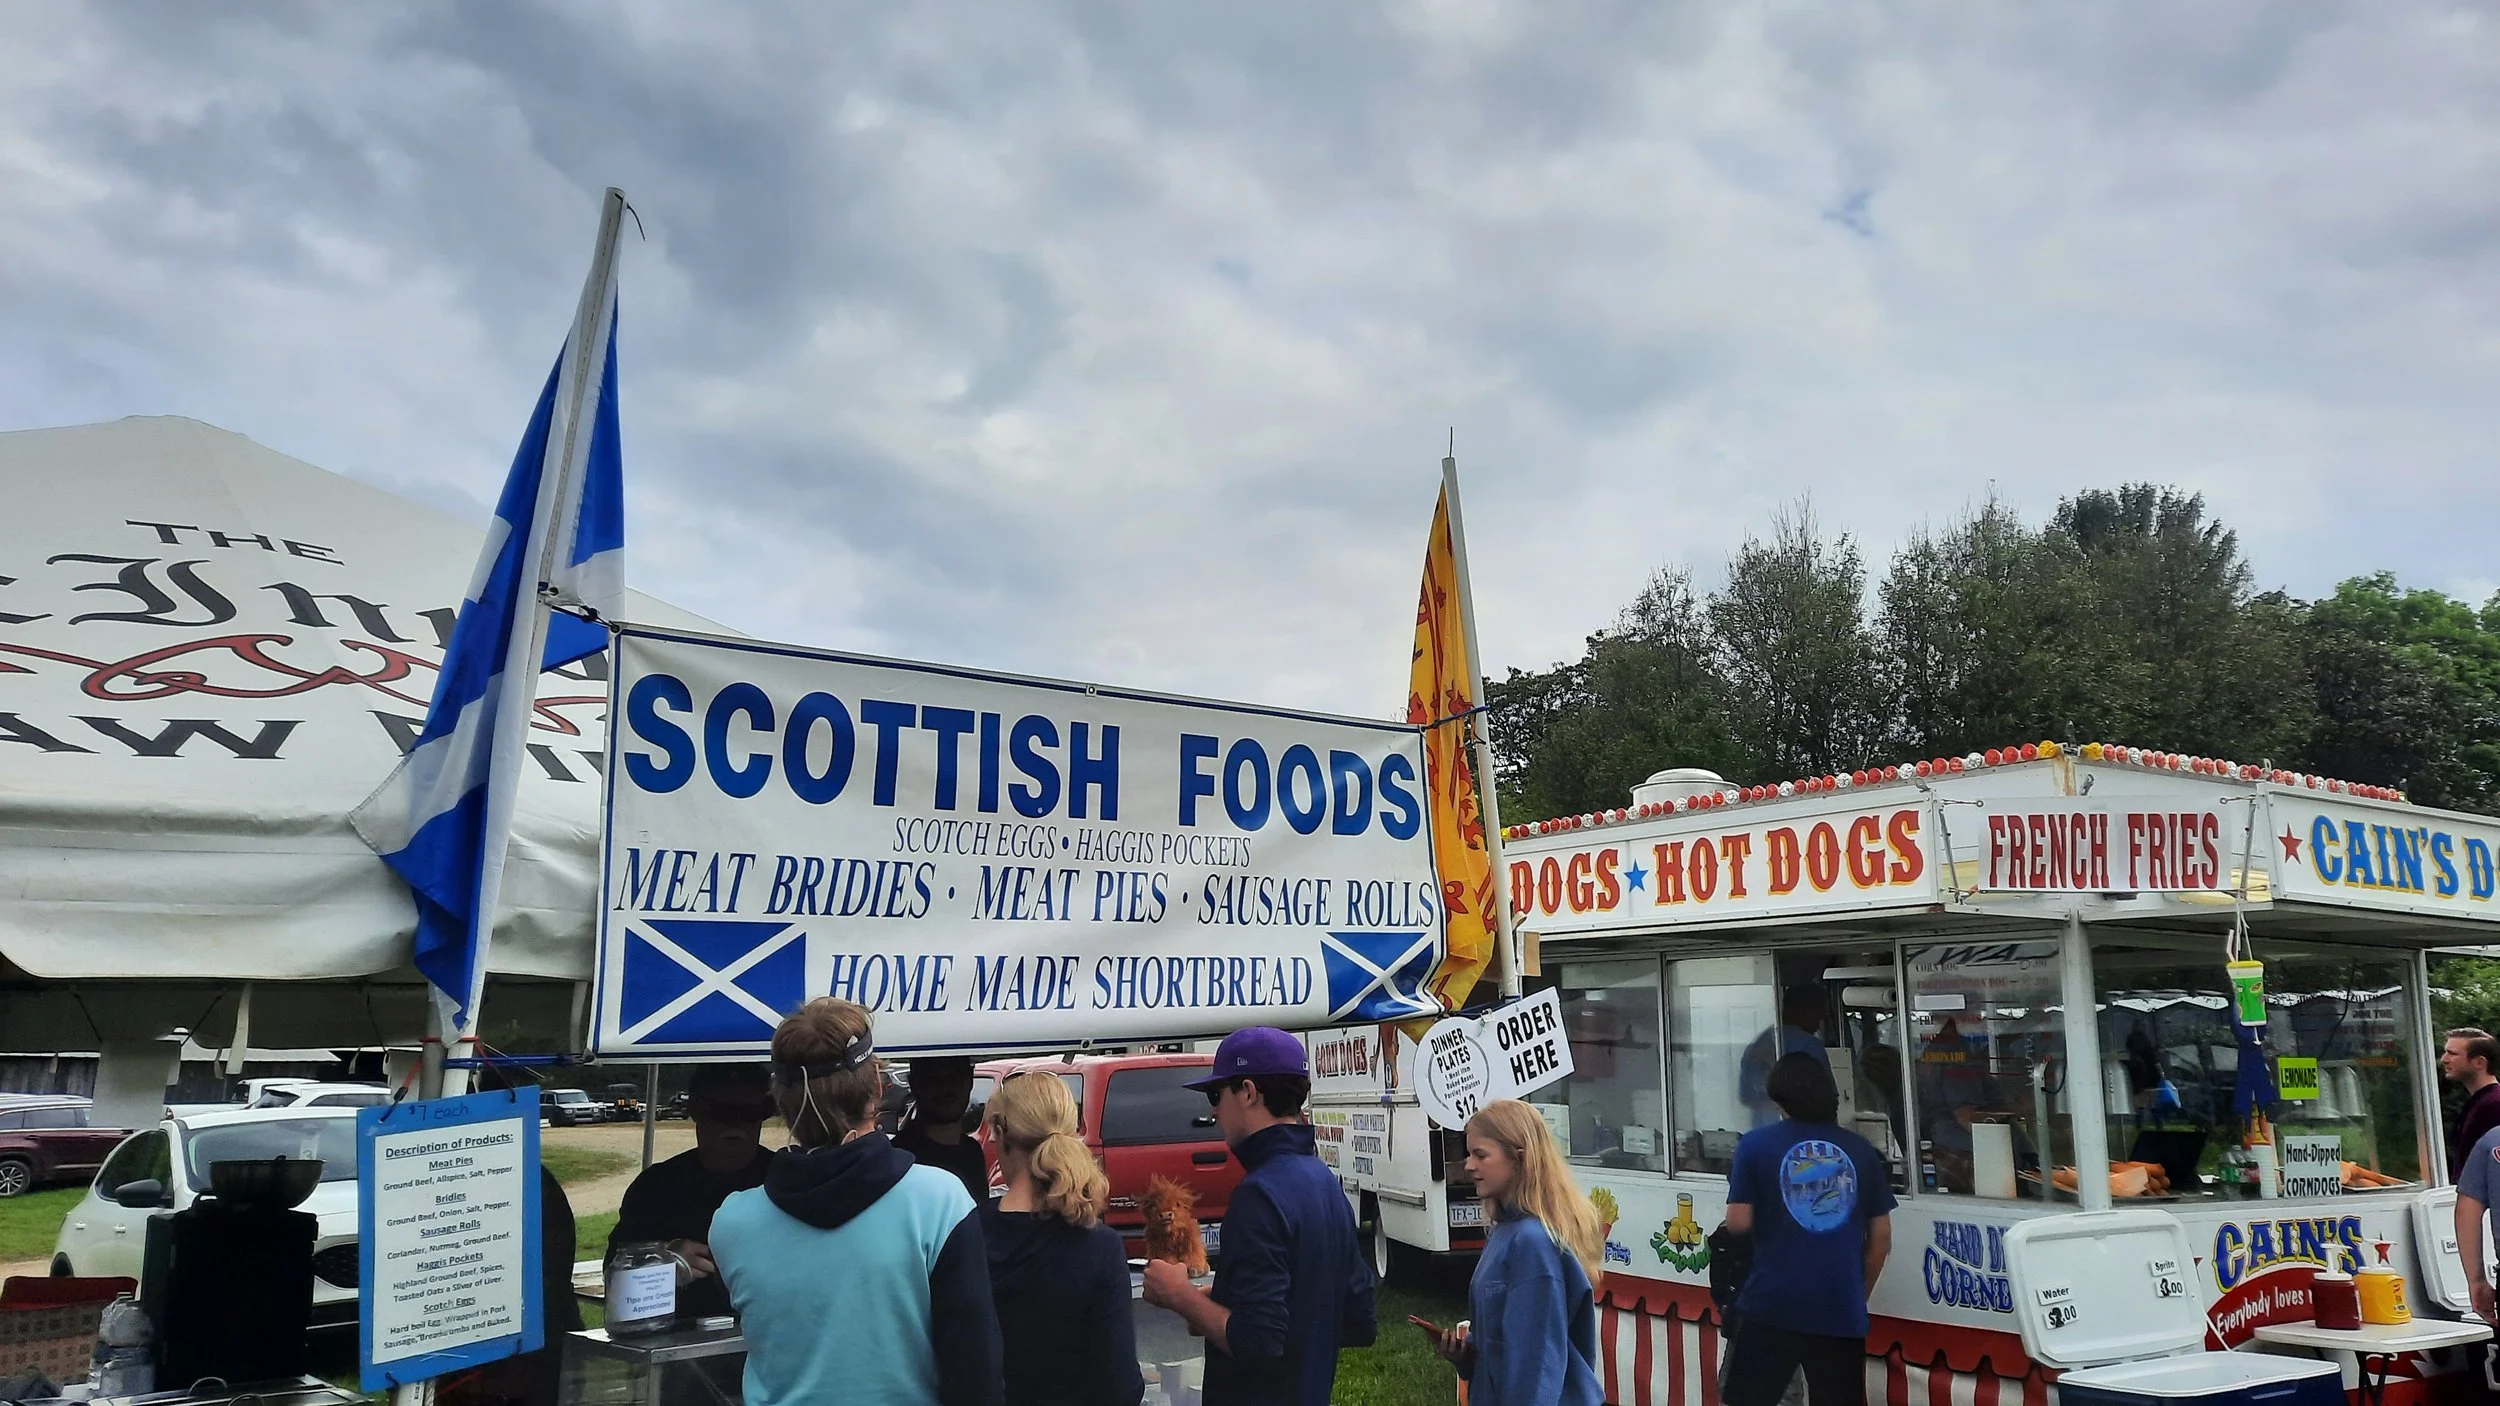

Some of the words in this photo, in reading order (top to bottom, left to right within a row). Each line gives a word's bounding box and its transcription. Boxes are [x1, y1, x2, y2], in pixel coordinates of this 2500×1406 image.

[125, 519, 345, 566] THE
[624, 674, 1120, 821] SCOTTISH
[1179, 733, 1420, 841] FOODS
[893, 817, 991, 856] SCOTCH
[996, 823, 1057, 860] EGGS
[1075, 828, 1154, 865] HAGGIS
[1160, 834, 1251, 868] POCKETS
[1988, 812, 2110, 889] FRENCH
[2128, 812, 2219, 889] FRIES
[1510, 847, 1620, 916] DOGS
[1653, 832, 1752, 906] HOT
[1766, 809, 1924, 896] DOGS
[2309, 815, 2460, 899] CAIN'S
[2461, 836, 2500, 901] D
[613, 847, 756, 914] MEAT
[763, 854, 936, 919] BRIDIES
[971, 865, 1080, 922] MEAT
[1091, 870, 1168, 924] PIES
[1197, 873, 1332, 927] SAUSAGE
[1345, 879, 1434, 928] ROLLS
[829, 953, 954, 1013] HOME
[965, 955, 1080, 1012] MADE
[1092, 955, 1312, 1010] SHORTBREAD
[1497, 1001, 1557, 1051] ORDER
[1431, 1027, 1466, 1055] DINNER
[1339, 1035, 1367, 1076] DOGS
[1436, 1046, 1471, 1073] PLATES
[1510, 1039, 1559, 1086] HERE
[2281, 1067, 2317, 1089] LEMONADE
[409, 1104, 427, 1121] $7
[1455, 1093, 1479, 1119] $12
[386, 1140, 448, 1158] Description
[450, 1138, 462, 1149] of
[465, 1133, 514, 1147] Products:
[2286, 1144, 2340, 1167] Hand-Dipped
[429, 1159, 453, 1169] Meat
[455, 1156, 474, 1165] Pies
[383, 1179, 413, 1191] Ground
[415, 1176, 435, 1187] Beef,
[436, 1172, 467, 1184] Allspice,
[469, 1169, 485, 1178] Salt,
[2286, 1177, 2340, 1197] CORNDOGS
[386, 1215, 416, 1227] Ground
[420, 1224, 458, 1237] Sausage
[459, 1219, 481, 1230] Rolls
[463, 1236, 491, 1246] Ground
[1933, 1220, 1984, 1269] HAND
[416, 1258, 447, 1270] Haggis
[450, 1252, 483, 1264] Pockets
[2155, 1260, 2175, 1272] Sprite
[2212, 1215, 2368, 1294] CAIN'S
[393, 1278, 427, 1290] Highland
[429, 1272, 458, 1283] Ground
[393, 1291, 424, 1303] Toasted
[426, 1287, 444, 1296] Oats
[452, 1282, 473, 1291] Sliver
[474, 1280, 483, 1288] of
[2043, 1287, 2069, 1299] Water
[423, 1300, 454, 1313] Scotch
[456, 1296, 476, 1307] Eggs
[2217, 1289, 2271, 1337] Everybody
[2275, 1286, 2305, 1310] loves
[390, 1323, 409, 1335] Hard
[410, 1319, 426, 1330] boil
[444, 1311, 480, 1324] Wrapped
[471, 1322, 486, 1331] and
